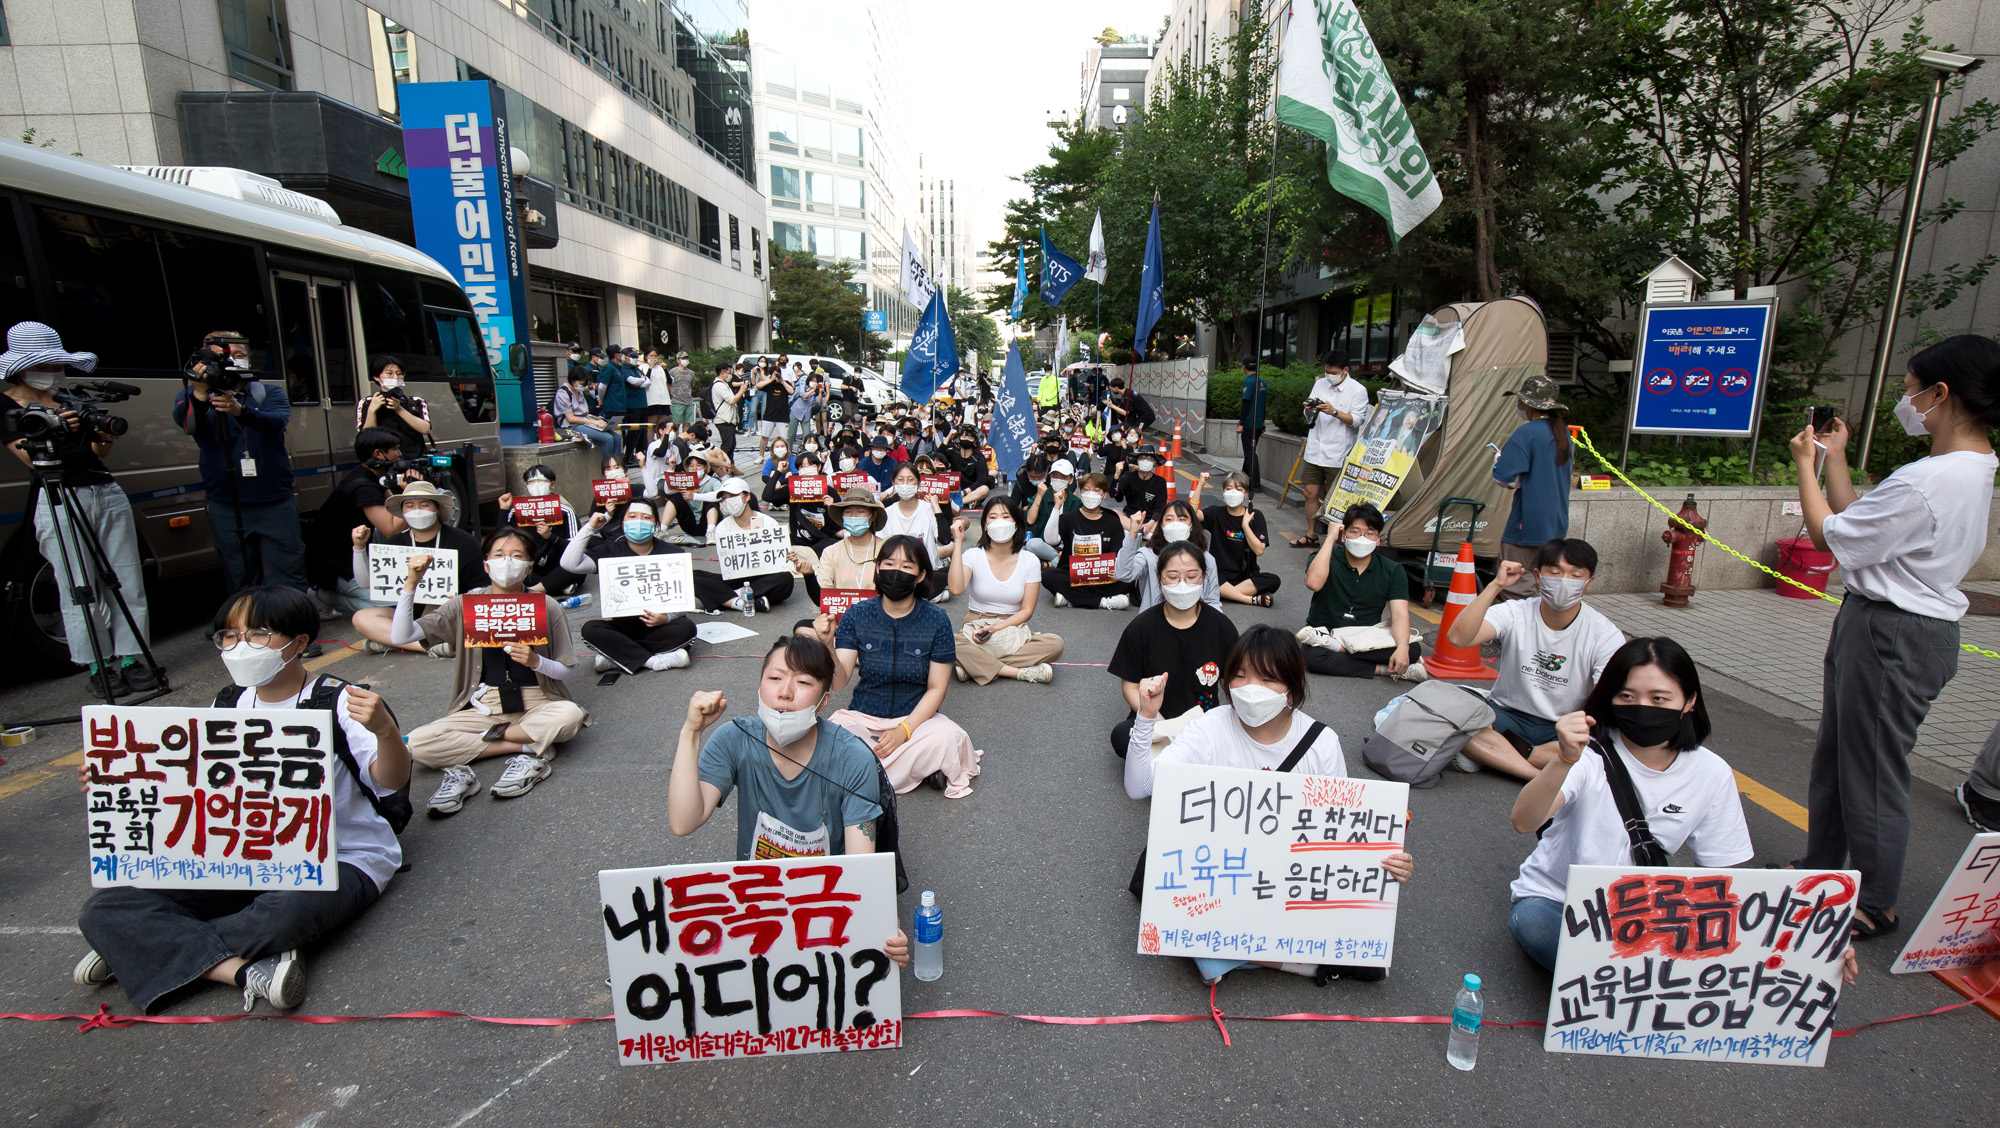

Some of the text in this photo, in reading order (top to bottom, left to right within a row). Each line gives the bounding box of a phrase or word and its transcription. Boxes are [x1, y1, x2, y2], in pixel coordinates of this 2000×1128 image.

[496, 117, 519, 277] Democratic Party of Korea
[444, 112, 506, 365] 더불어민주당
[871, 312, 880, 320] Sh
[1662, 326, 1749, 336] 이곳은 어린이집입니다
[1668, 342, 1736, 355] 배려해 주세요
[1686, 375, 1709, 386] 흡연
[1722, 375, 1747, 387] 과속
[794, 480, 822, 488] 학생의견
[515, 502, 536, 510] 상반기
[1071, 561, 1092, 570] 상반기
[614, 562, 661, 587] 등록금
[637, 580, 682, 602] 반환!!
[823, 596, 849, 606] 상반기
[474, 603, 535, 617] 학생의견
[475, 617, 536, 632] 즉각수용!
[1535, 667, 1569, 683] balance
[89, 785, 332, 863] 교육부 기억할게
[1285, 862, 1398, 901] 응답하라
[1161, 928, 1388, 959] 계원예술대학교 제27대 총학생회
[626, 948, 891, 1040] 어디에?
